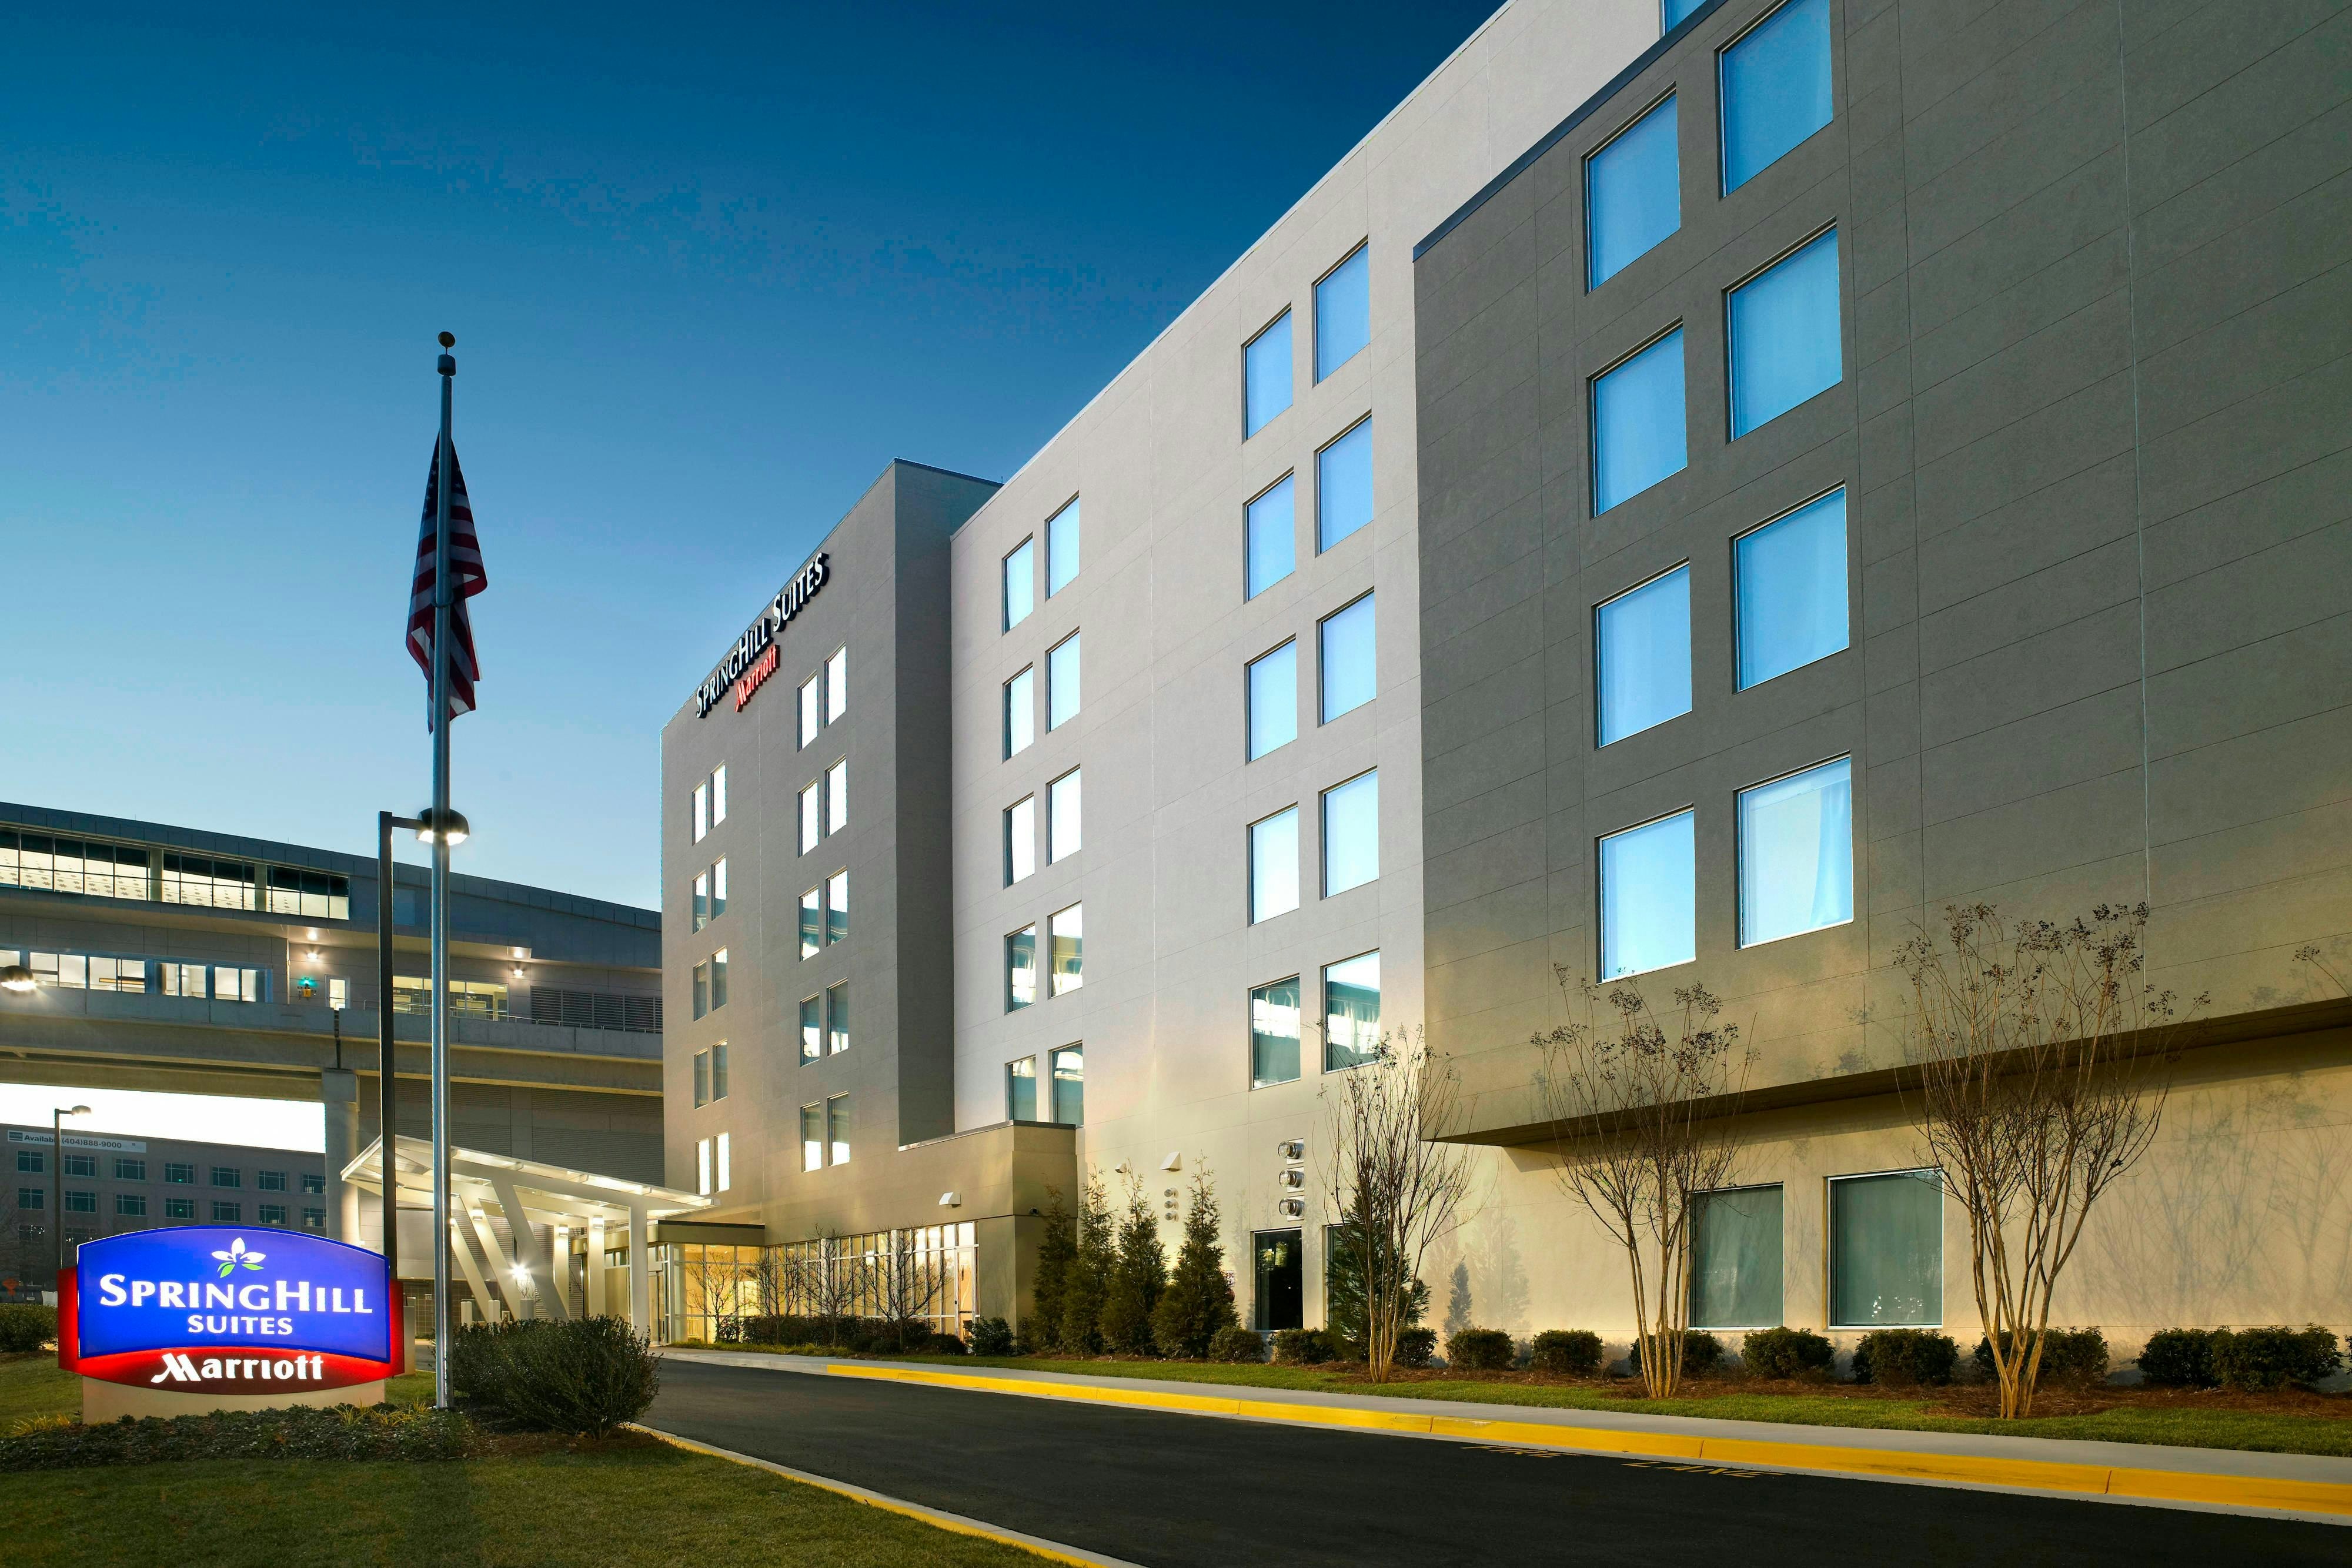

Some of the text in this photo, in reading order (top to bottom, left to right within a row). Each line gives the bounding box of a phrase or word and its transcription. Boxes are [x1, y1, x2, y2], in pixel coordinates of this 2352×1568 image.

[696, 552, 828, 718] SPRINGHILL SUITES
[734, 644, 779, 712] Marriott
[62, 1138, 122, 1148] (404)888-9000
[100, 1274, 373, 1313] SPRINGHILL
[188, 1315, 293, 1335] SUITES
[151, 1353, 323, 1383] Marriott
[1460, 1445, 1786, 1478] FIRE LANE
